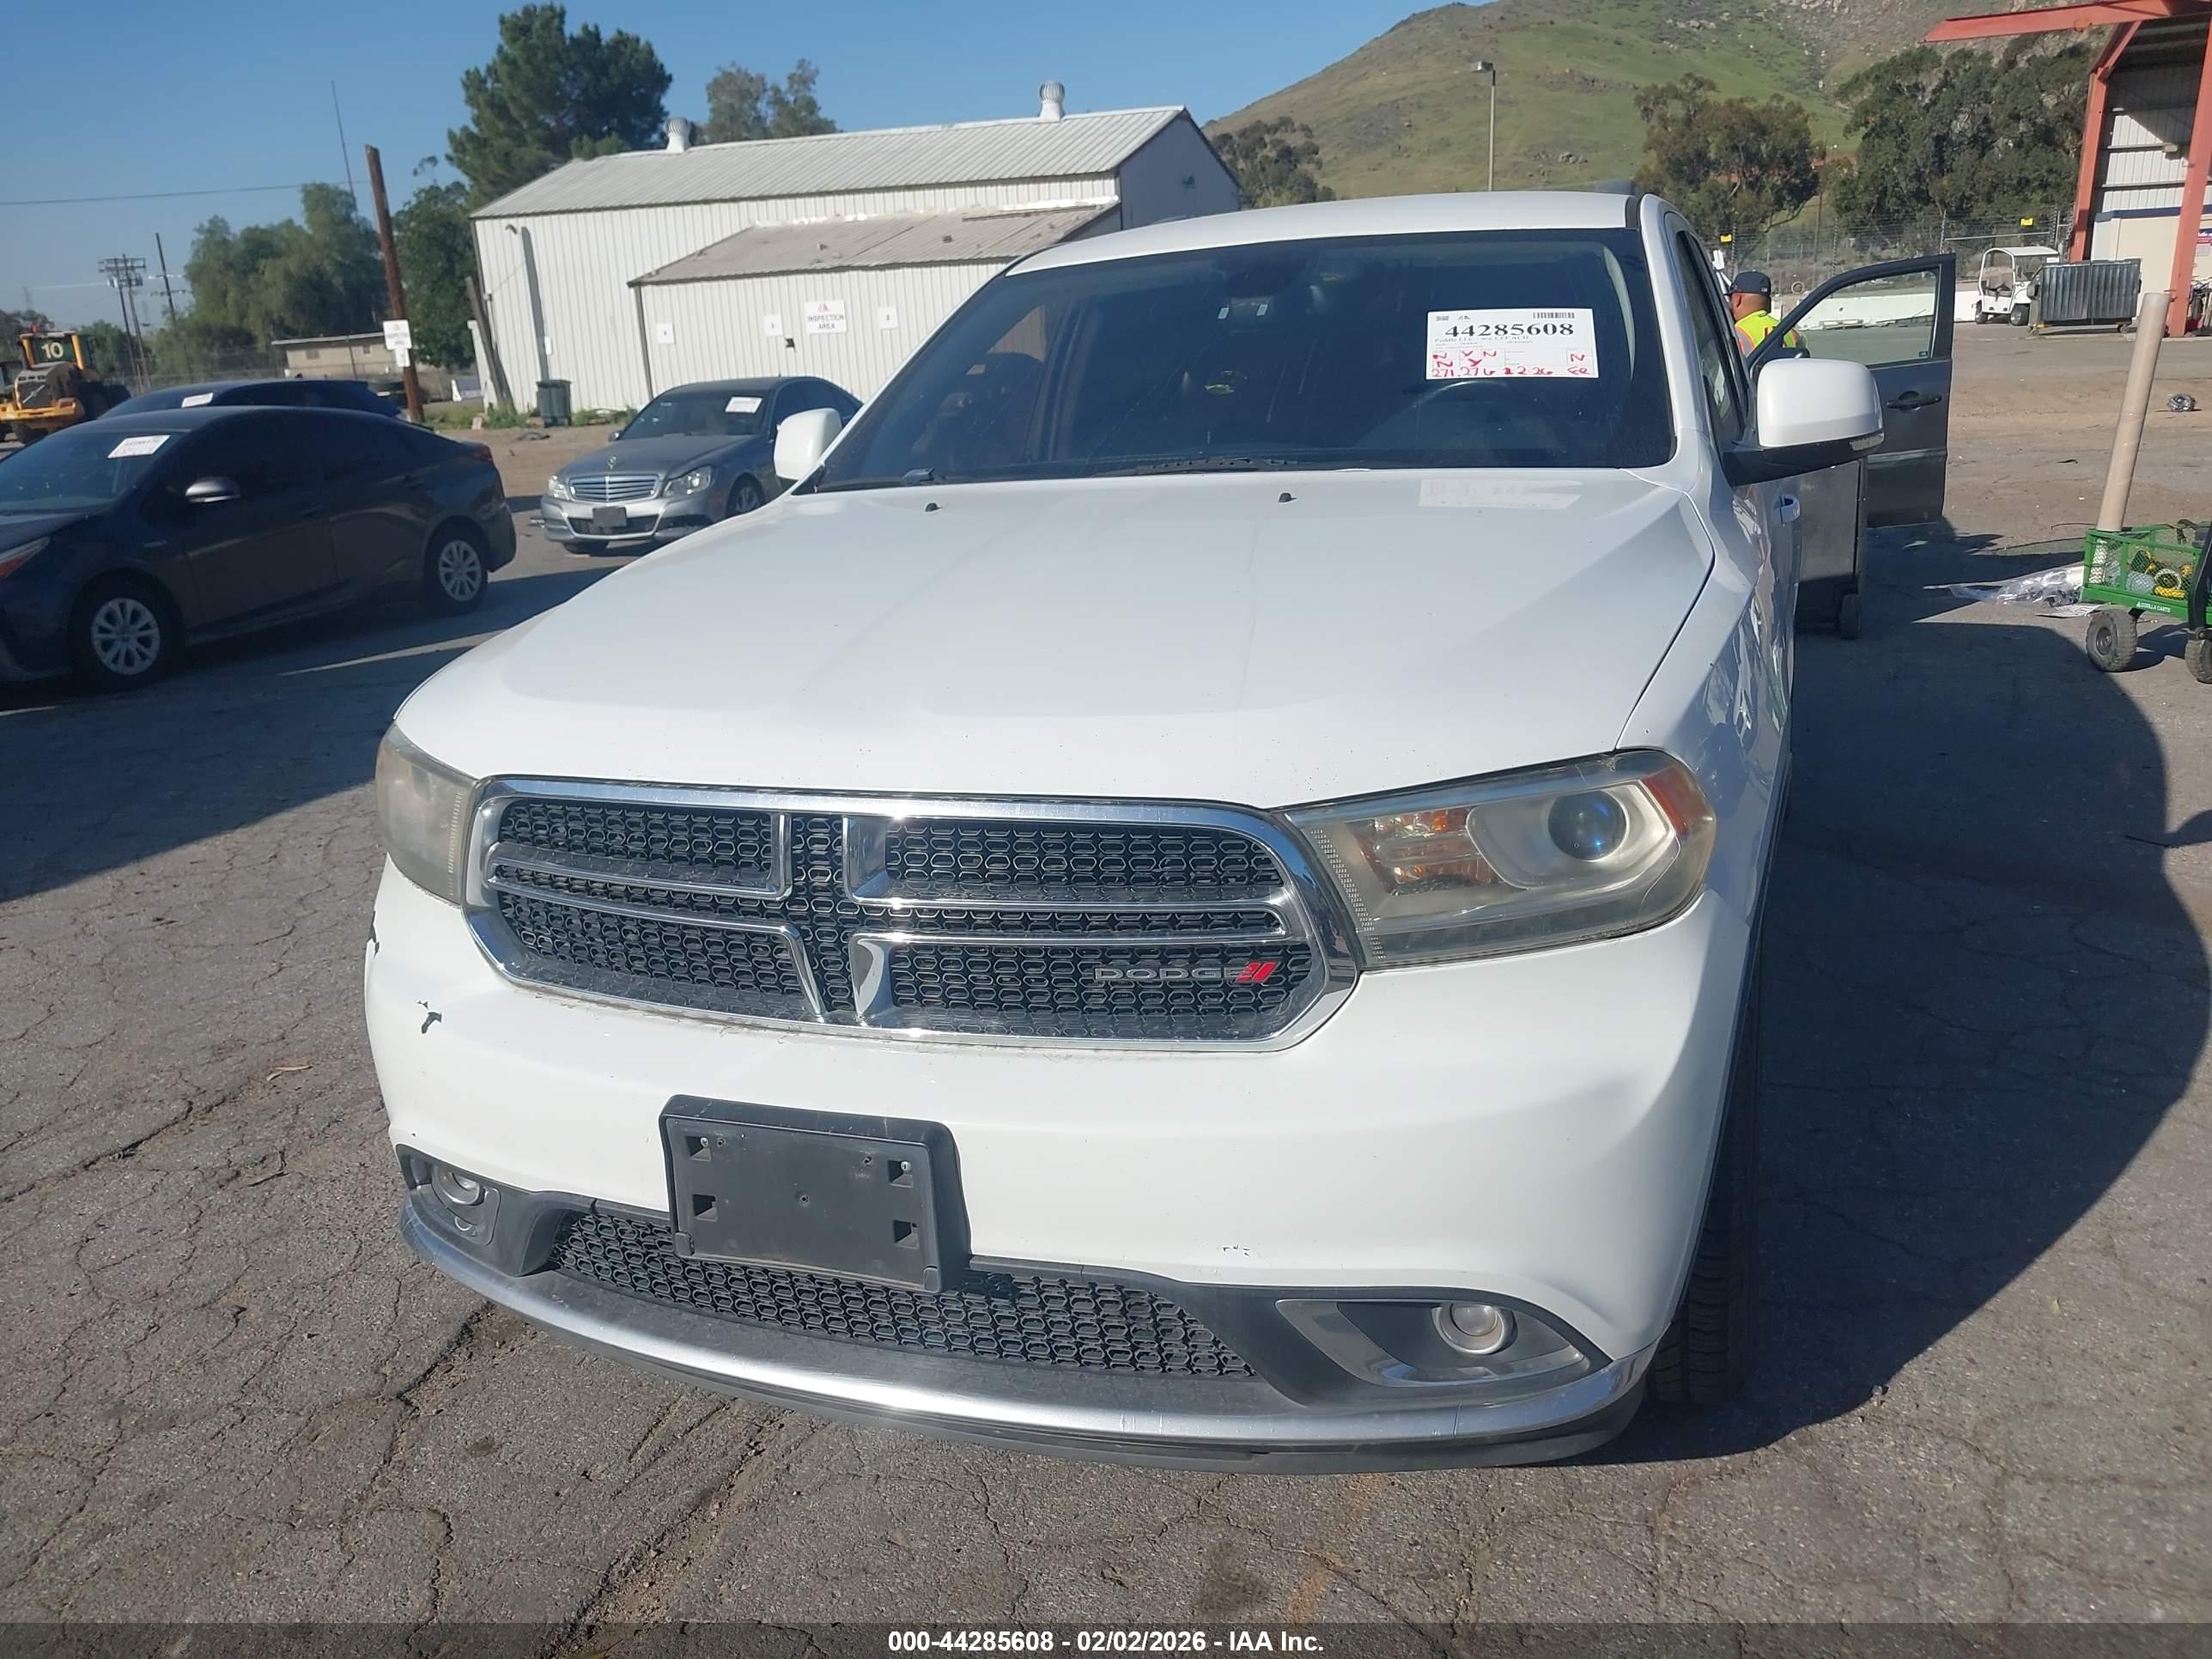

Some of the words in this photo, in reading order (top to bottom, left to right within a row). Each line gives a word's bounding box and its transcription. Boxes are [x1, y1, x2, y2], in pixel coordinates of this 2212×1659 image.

[1444, 323, 1574, 337] 44285608
[41, 342, 64, 359] 10
[1095, 967, 1252, 980] DODGE
